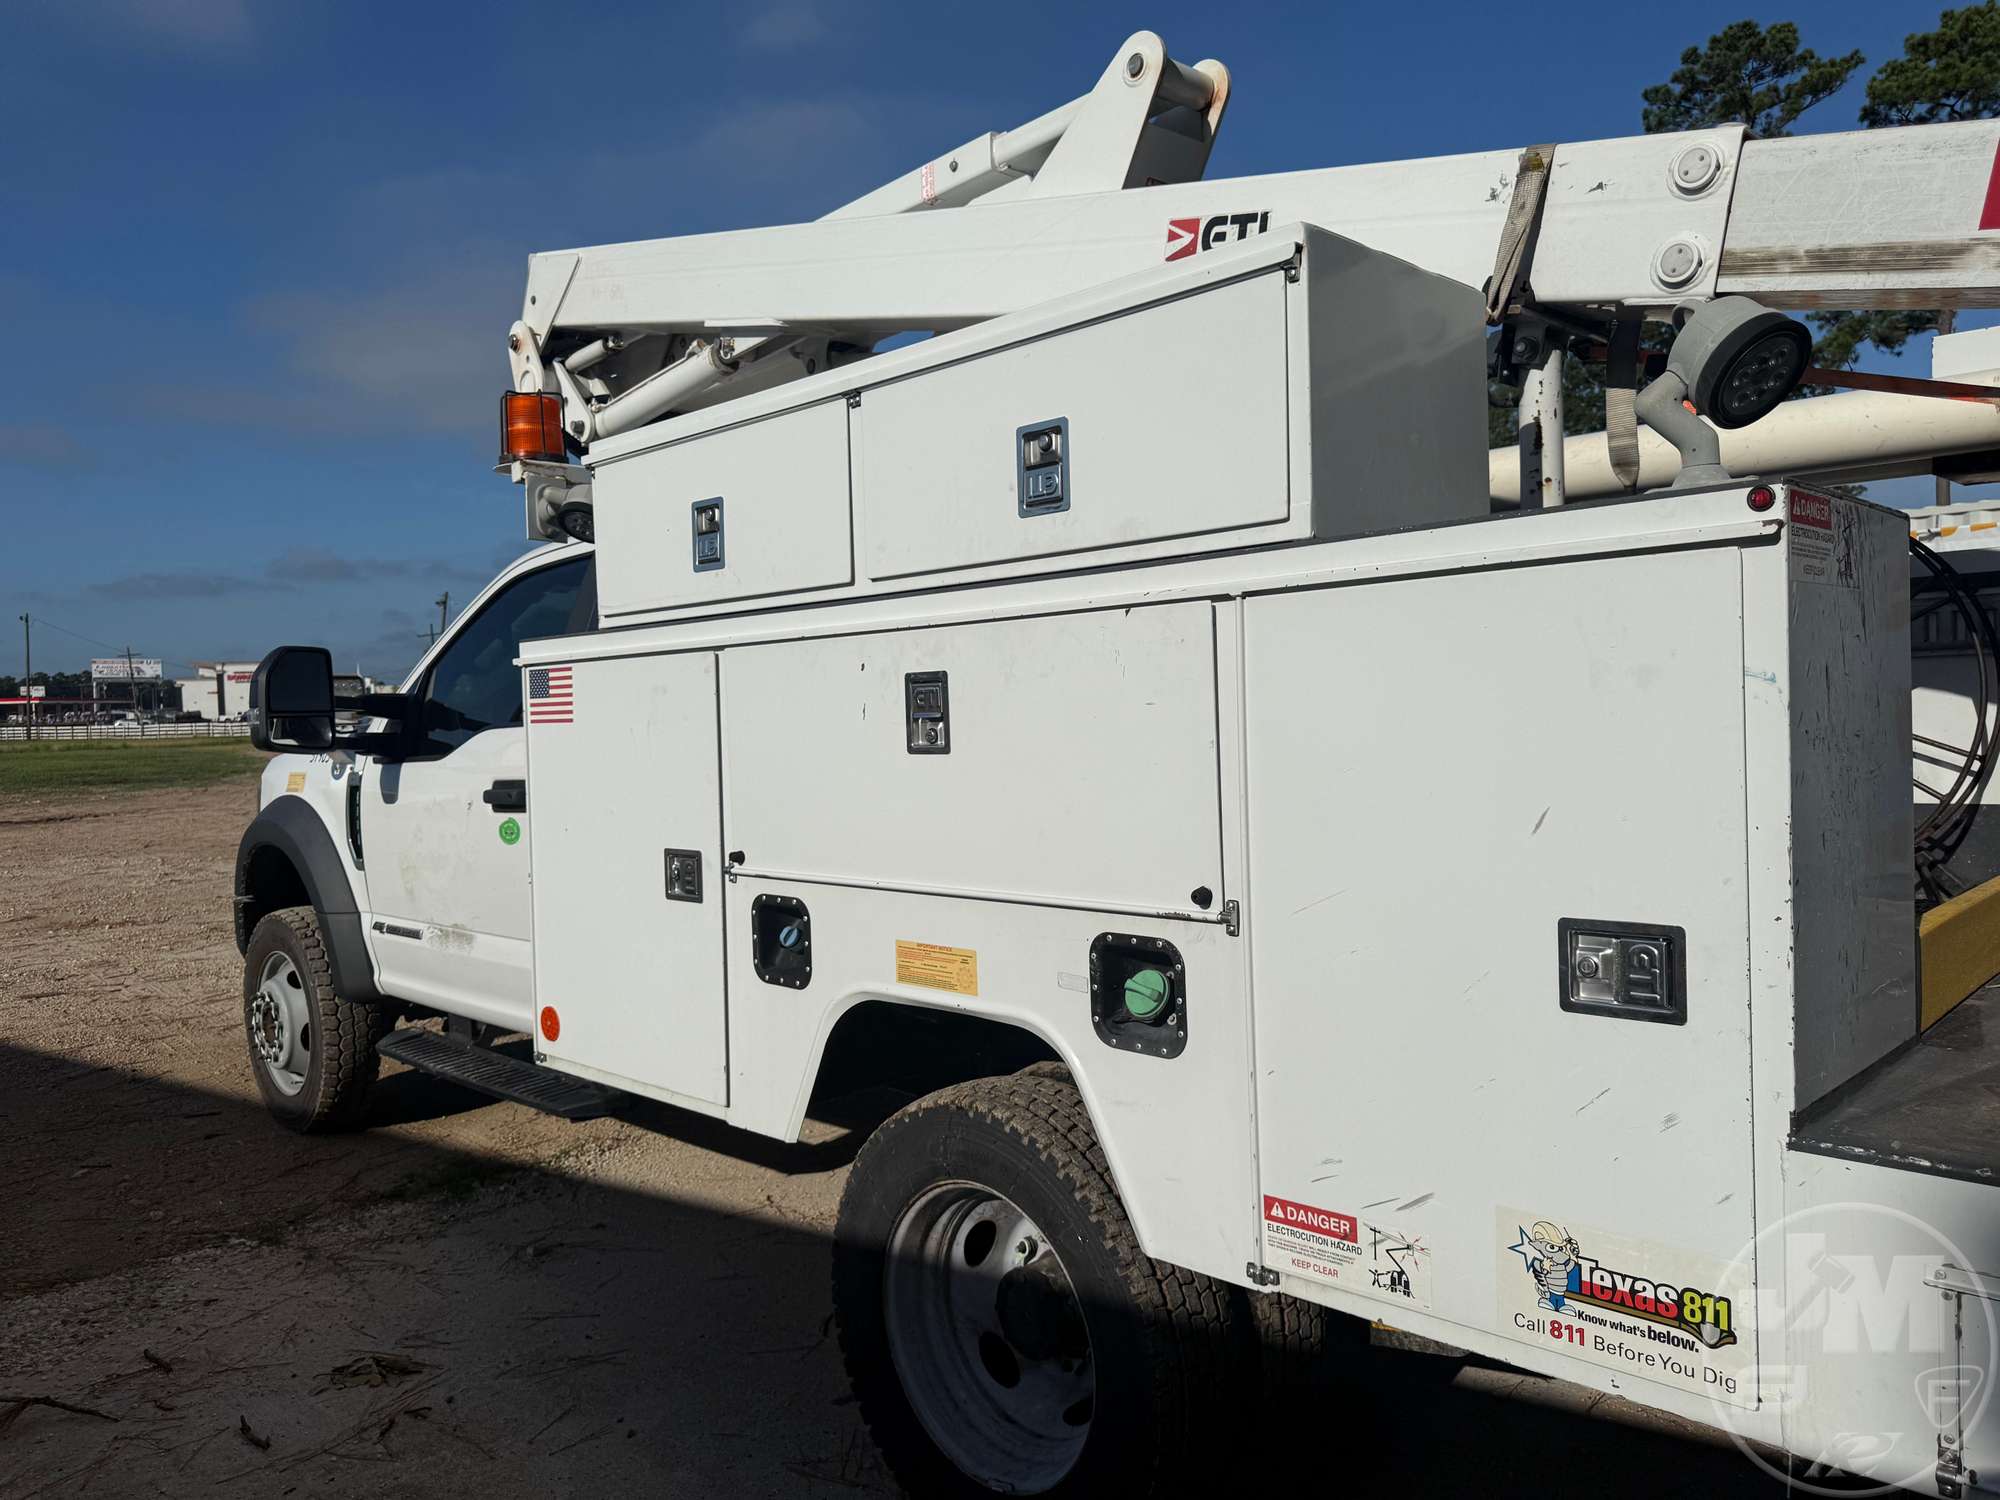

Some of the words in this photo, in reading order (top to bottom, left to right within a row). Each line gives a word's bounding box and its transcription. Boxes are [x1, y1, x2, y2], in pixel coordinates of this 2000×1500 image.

[1801, 499, 1830, 521] DANGER
[1287, 1206, 1351, 1235] DANGER
[1267, 1223, 1329, 1247] ELECTROCUTION
[1330, 1240, 1363, 1256] HAZARD
[1291, 1257, 1311, 1270] KEEP
[1312, 1262, 1339, 1278] CLEAR
[1577, 1256, 1680, 1322] Texas
[1682, 1288, 1732, 1332] 811
[1577, 1308, 1608, 1328] Know
[1609, 1318, 1647, 1338] what's
[1647, 1325, 1700, 1353] below.
[1513, 1312, 1547, 1335] Call
[1549, 1319, 1585, 1347] 811
[1593, 1335, 1656, 1367] Before
[1658, 1353, 1696, 1379] You
[1703, 1366, 1737, 1394] Dig
